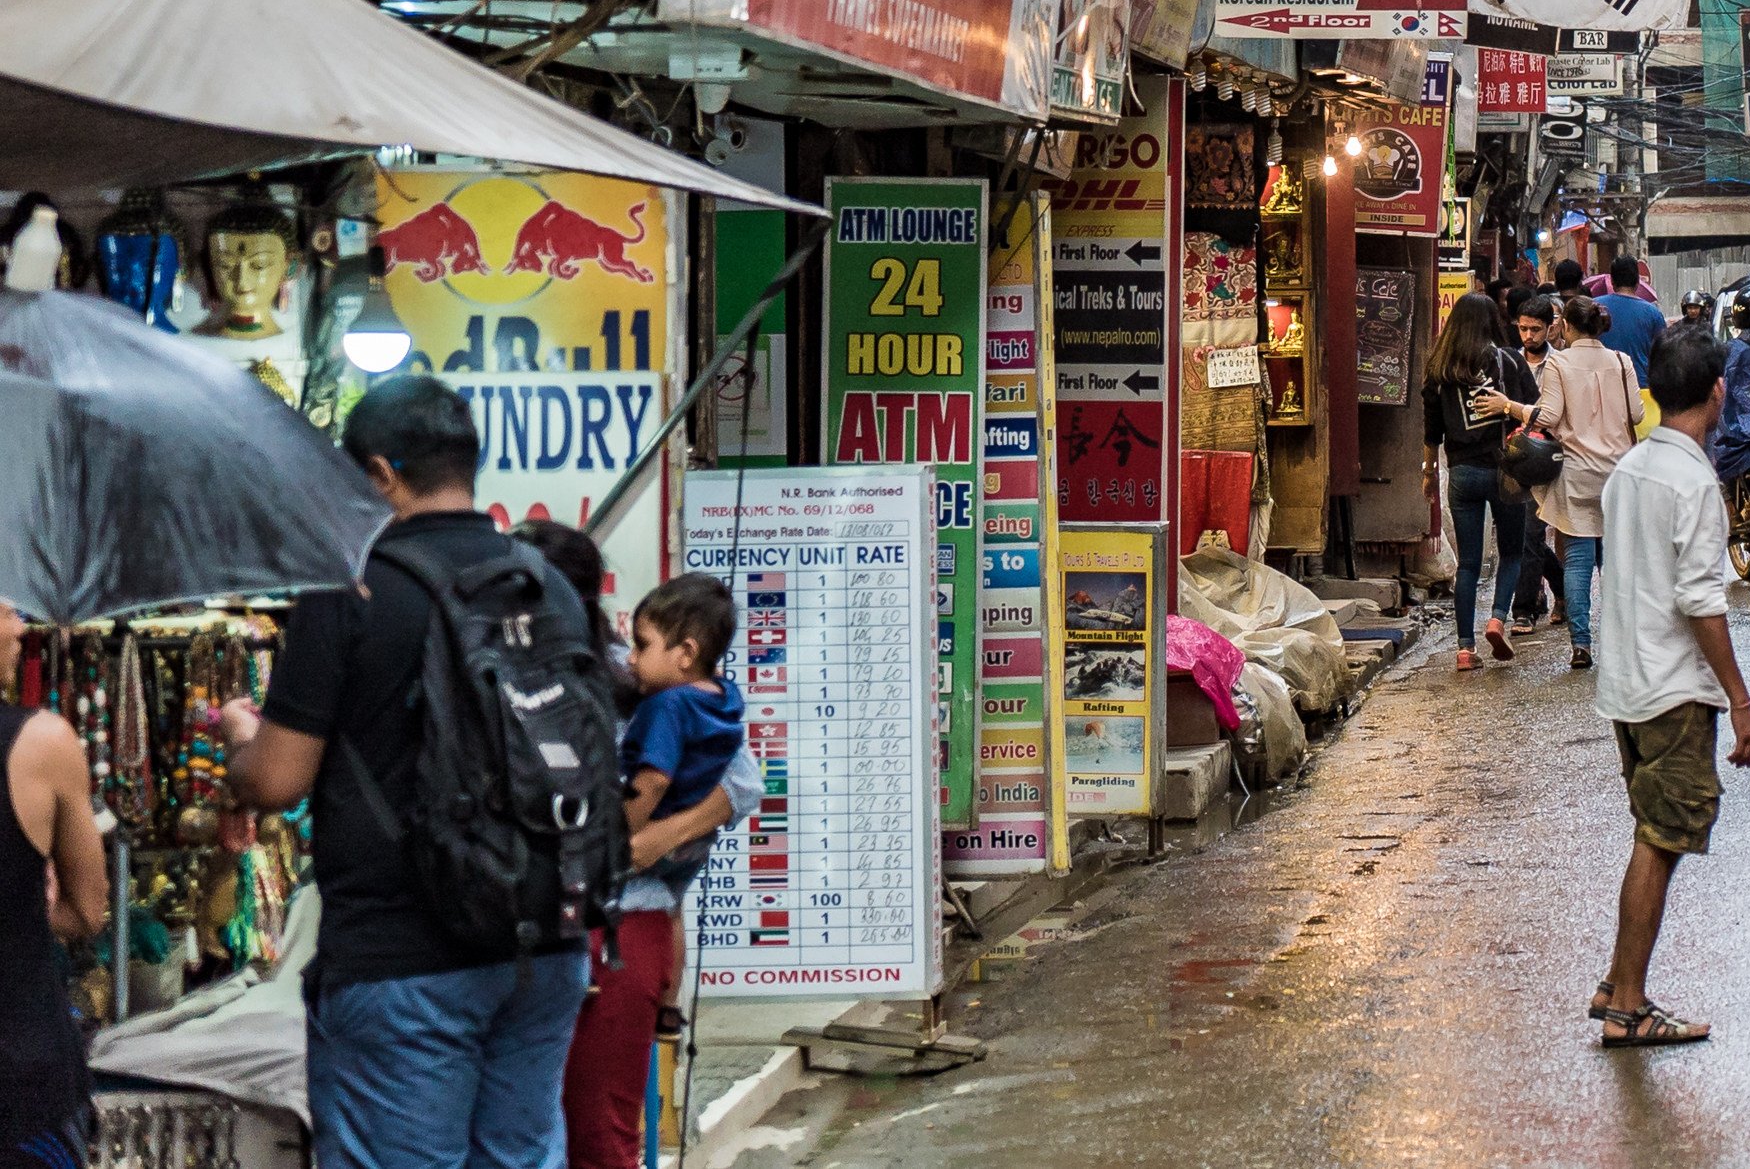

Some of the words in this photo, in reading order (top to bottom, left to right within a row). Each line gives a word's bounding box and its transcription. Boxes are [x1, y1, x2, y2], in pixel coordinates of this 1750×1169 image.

[1250, 15, 1303, 28] 2nd
[1308, 15, 1369, 27] Floor
[1577, 31, 1605, 46] BAR
[1399, 106, 1442, 128] CAFE
[837, 207, 885, 244] ATM
[891, 207, 978, 245] LOUNGE
[1370, 214, 1404, 223] INSIDE
[1066, 225, 1114, 237] EXPRESS
[1060, 244, 1086, 260] First
[1090, 244, 1120, 260] Floor
[869, 257, 945, 317] 24
[1079, 286, 1112, 311] Treks
[1131, 286, 1163, 311] Tours
[1060, 329, 1161, 347] (www.nepalro.com)
[846, 332, 965, 377] HOUR
[1058, 374, 1084, 390] First
[1088, 374, 1118, 390] Floor
[835, 391, 972, 463] ATM
[807, 487, 836, 498] Bank
[840, 487, 903, 497] Authorised
[803, 503, 875, 516] 69/12/068
[686, 547, 791, 567] CURRENCY
[800, 546, 845, 565] UNIT
[856, 545, 904, 564] RATE
[1068, 631, 1113, 641] Mountain
[1116, 631, 1143, 641] Flight
[1083, 703, 1125, 714] Rafting
[1072, 776, 1135, 787] Paragliding
[995, 783, 1039, 802] India
[956, 834, 982, 849] on
[990, 831, 1037, 849] Hire
[696, 895, 742, 908] KRW
[810, 893, 841, 906] 100
[701, 971, 735, 985] NO
[744, 968, 900, 984] COMMISSION
